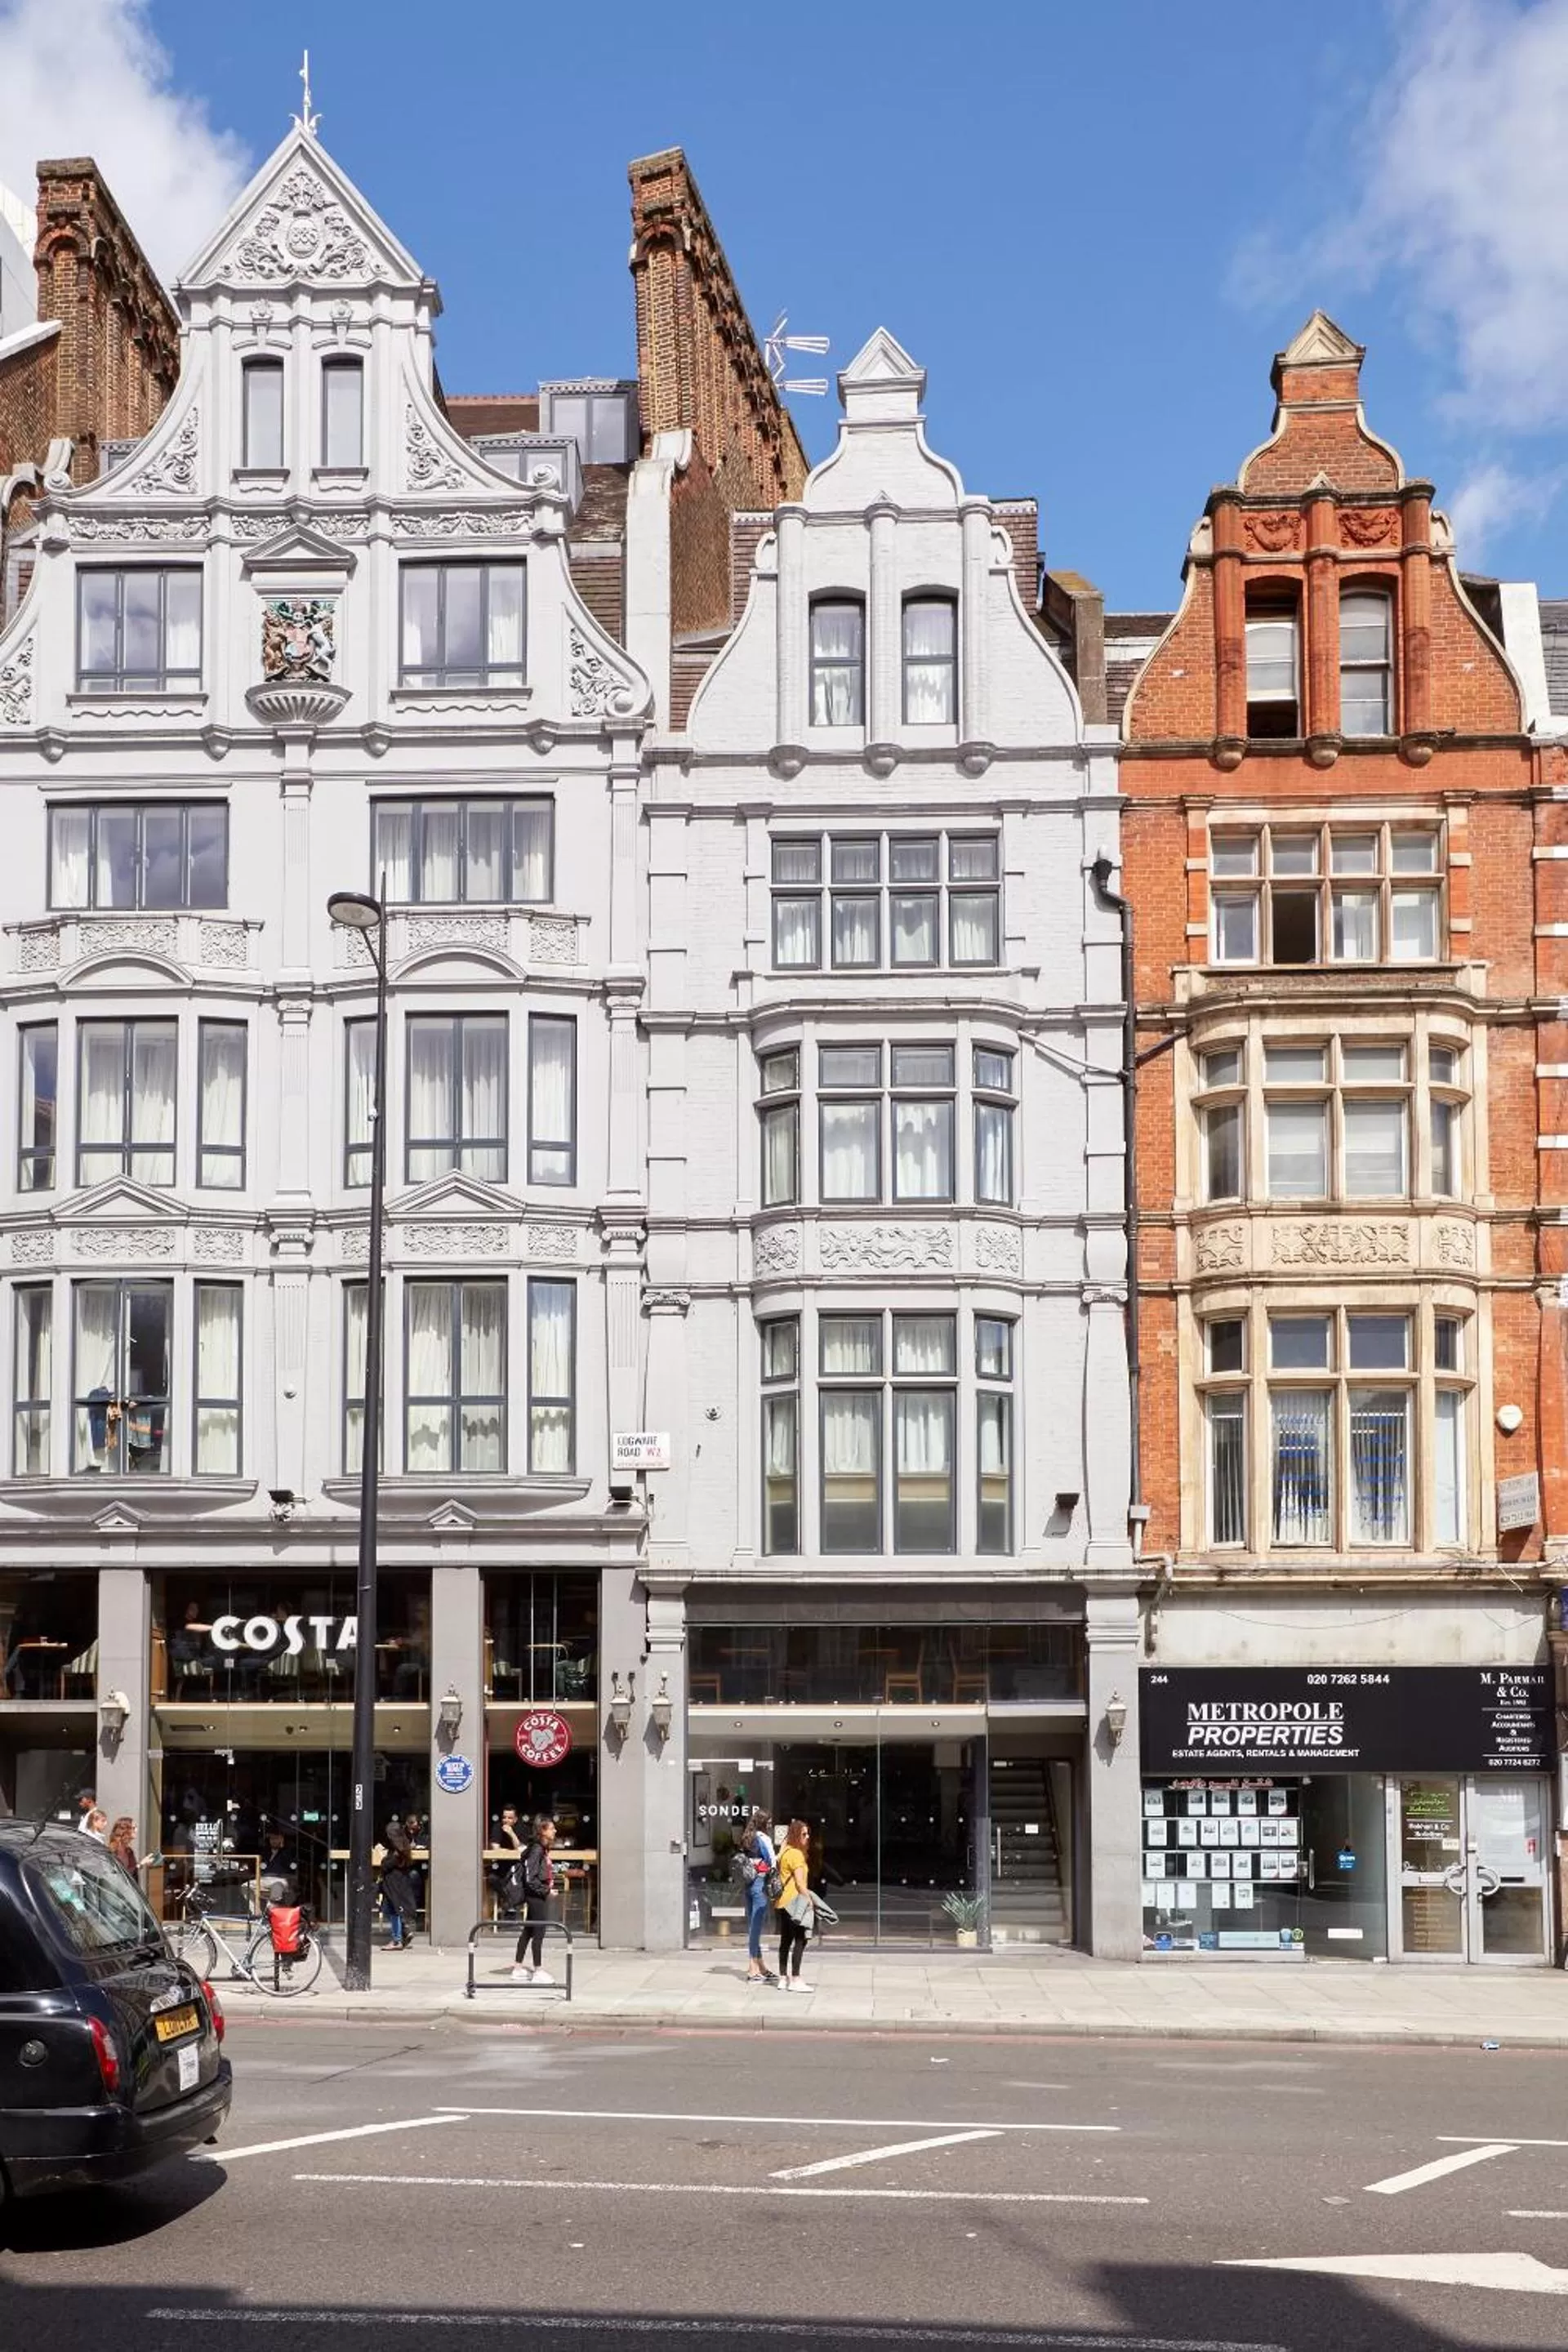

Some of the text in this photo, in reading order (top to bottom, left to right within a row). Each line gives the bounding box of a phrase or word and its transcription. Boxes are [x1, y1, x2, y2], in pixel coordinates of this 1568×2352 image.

[617, 1446, 640, 1457] ROAD
[211, 1615, 358, 1655] COSTA
[1151, 1675, 1168, 1684] 244
[1307, 1674, 1390, 1684] 020 7262 5844
[1480, 1673, 1496, 1685] M.
[1497, 1686, 1507, 1697] &
[1187, 1702, 1343, 1721] METROPOLE
[523, 1715, 559, 1731] COSTA
[1188, 1726, 1343, 1745] PROPERTIES
[522, 1744, 564, 1762] COFFEE
[1207, 1749, 1244, 1758] AGENTS,
[699, 1805, 760, 1816] SONDER
